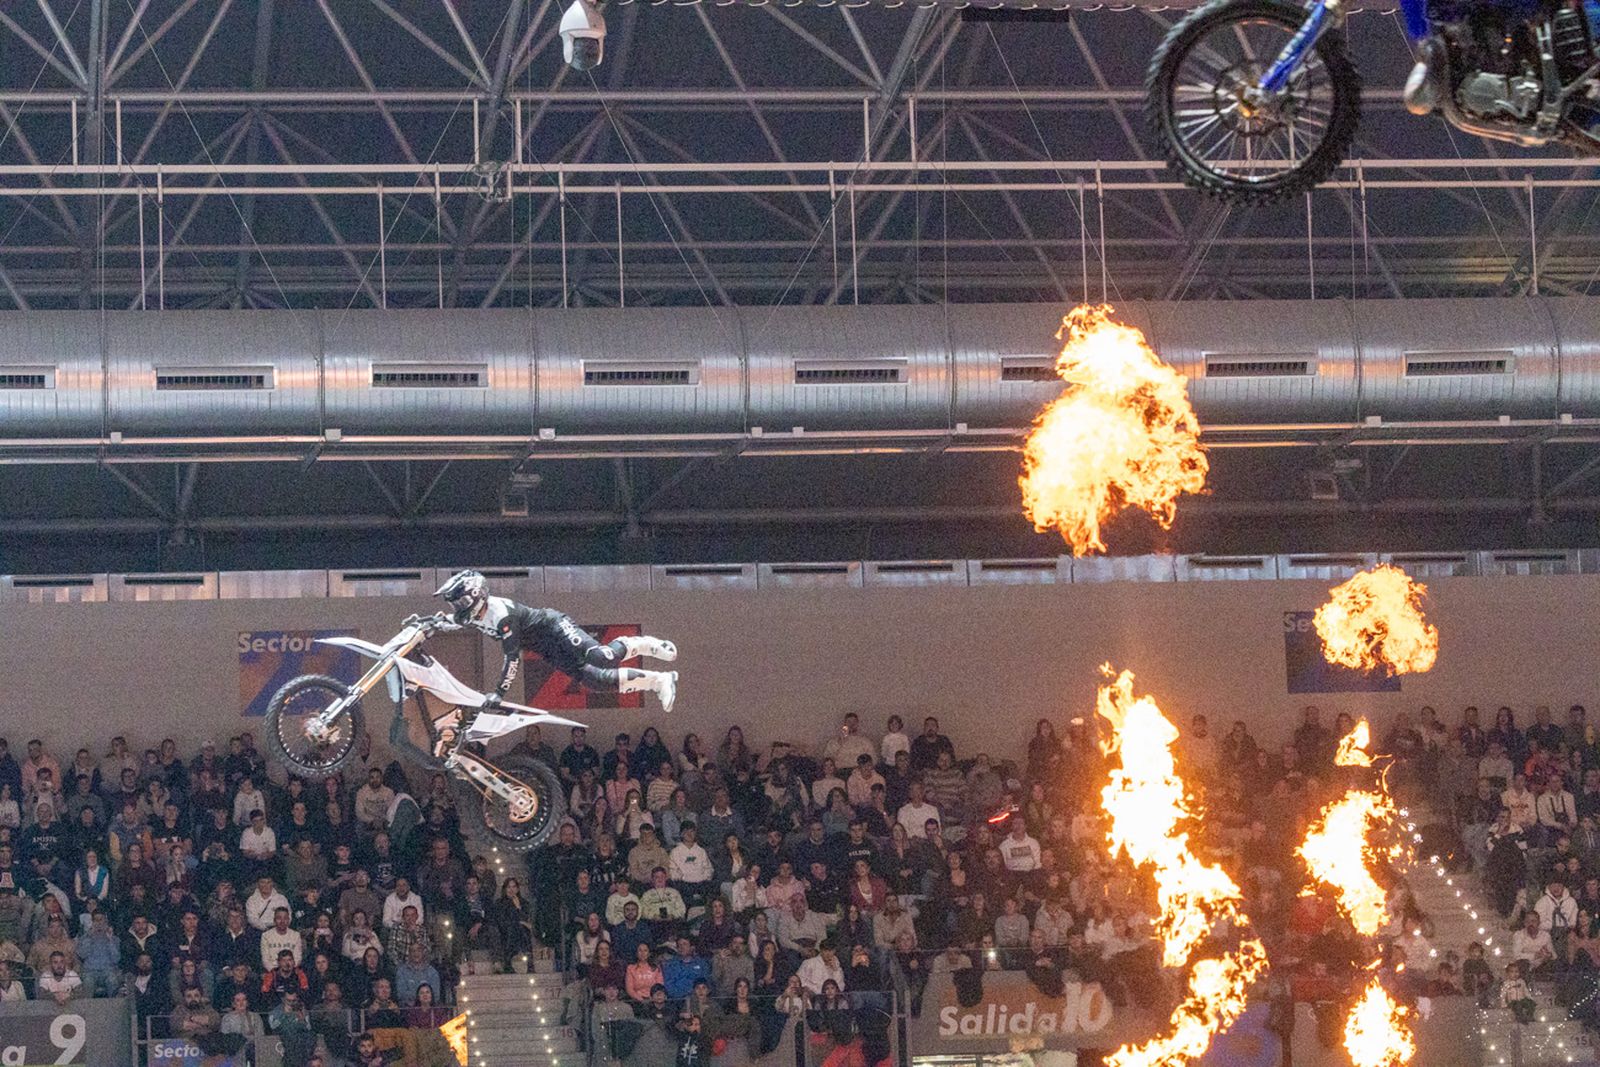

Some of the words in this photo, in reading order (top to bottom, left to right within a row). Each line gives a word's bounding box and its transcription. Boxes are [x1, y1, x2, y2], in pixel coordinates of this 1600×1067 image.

[238, 632, 314, 653] Sector
[938, 1001, 1058, 1036] Salida
[1063, 981, 1113, 1033] 10
[0, 1044, 26, 1066] a
[49, 1013, 86, 1065] 9
